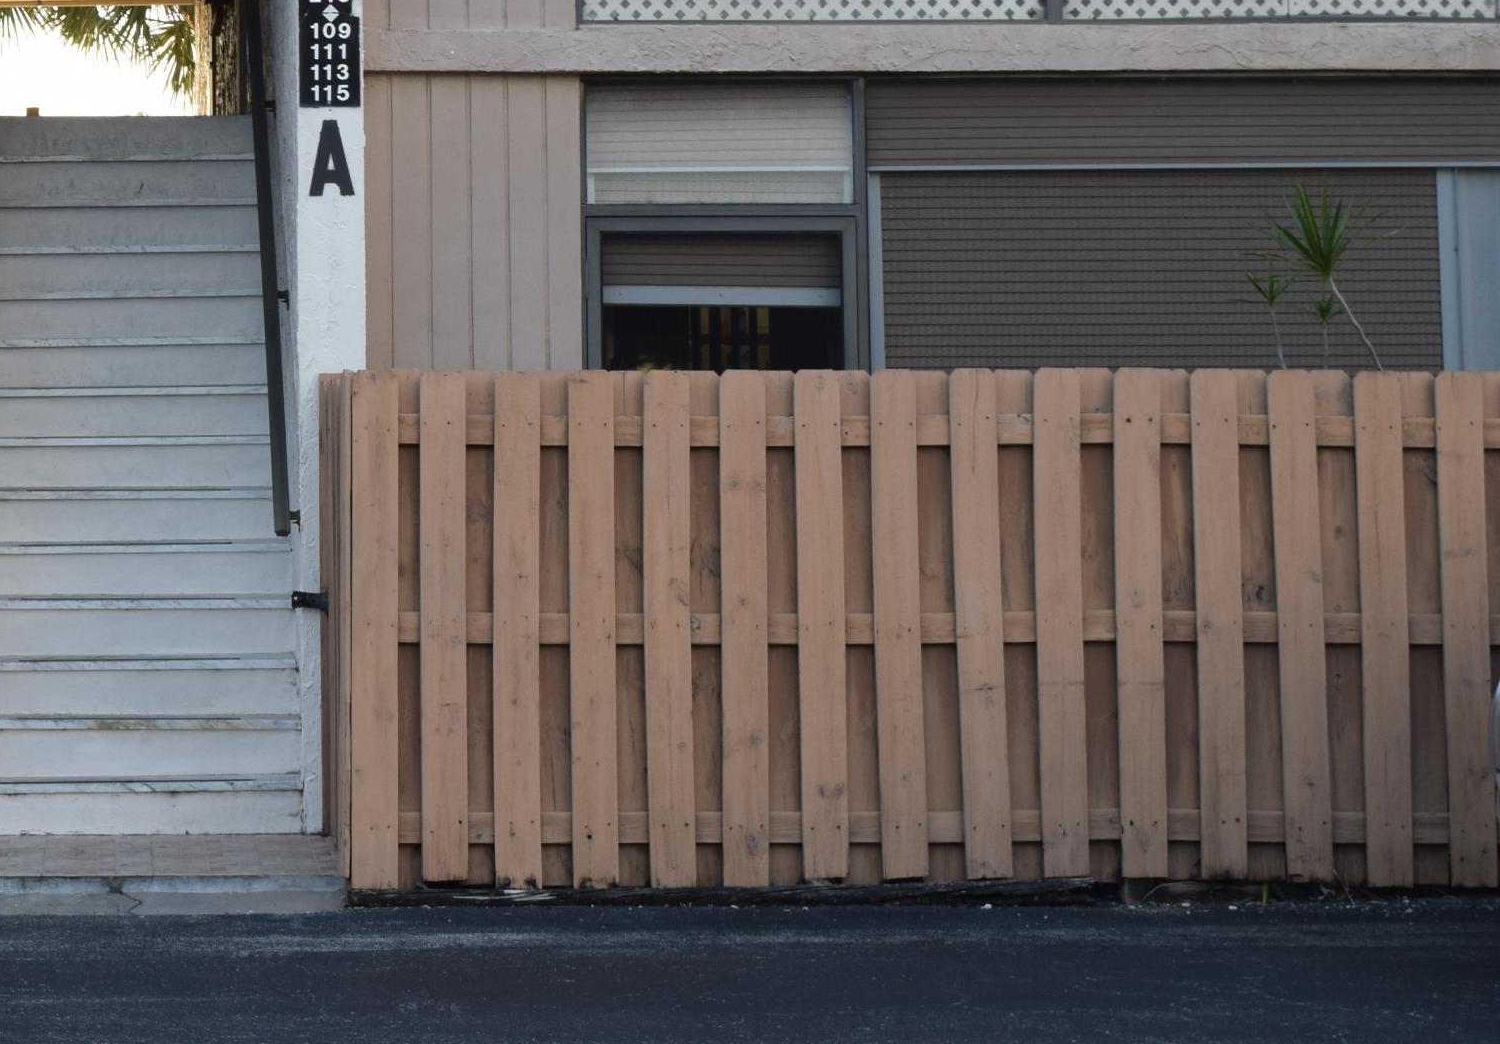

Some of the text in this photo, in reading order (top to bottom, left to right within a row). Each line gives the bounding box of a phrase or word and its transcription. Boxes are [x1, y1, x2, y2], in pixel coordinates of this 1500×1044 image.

[310, 23, 351, 39] 109
[310, 43, 347, 60] 111
[310, 64, 350, 81] 113
[311, 84, 350, 101] 115
[308, 120, 355, 196] A
